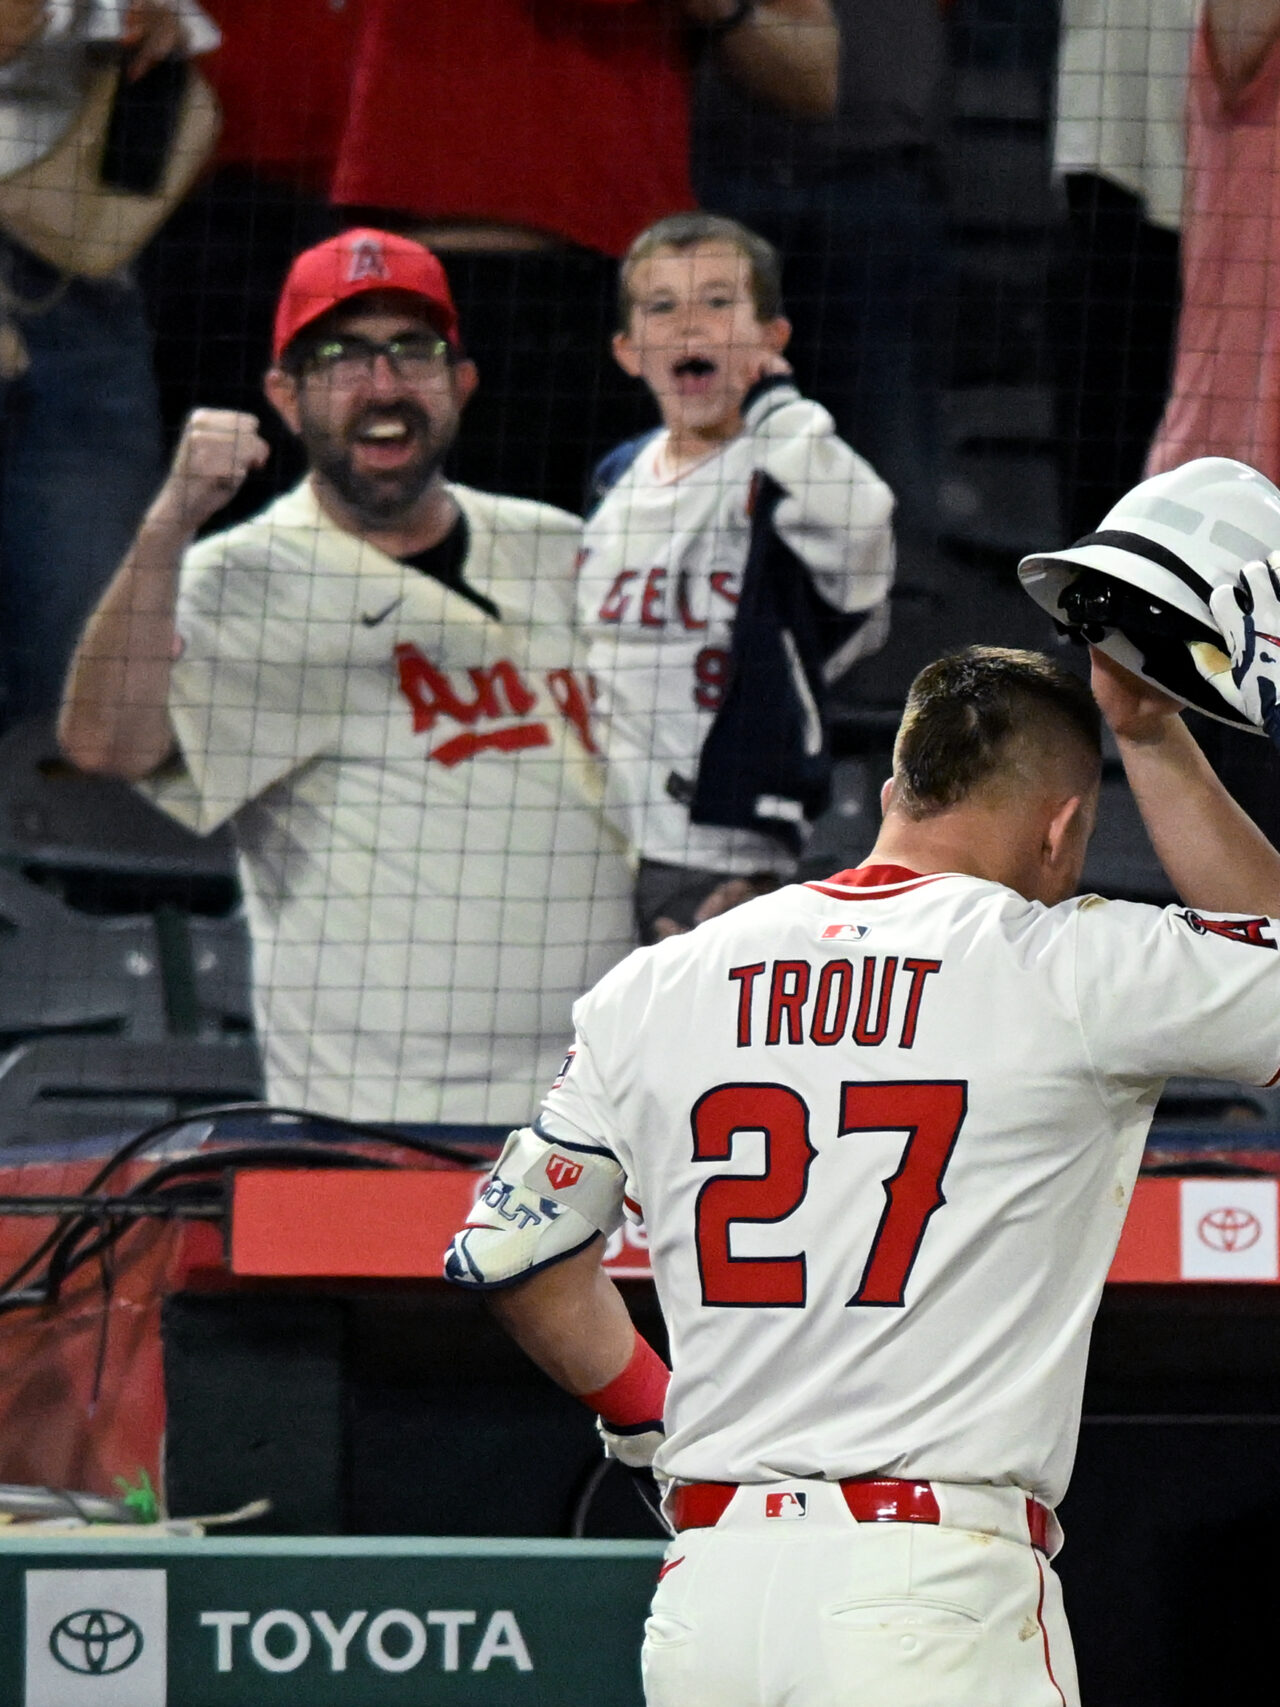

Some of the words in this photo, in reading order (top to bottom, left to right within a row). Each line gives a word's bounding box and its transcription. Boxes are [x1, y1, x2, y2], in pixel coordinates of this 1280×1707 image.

[394, 642, 602, 756] Ang
[729, 956, 942, 1049] TROUT
[690, 1080, 968, 1308] 27
[200, 1609, 534, 1672] TOYOTA
